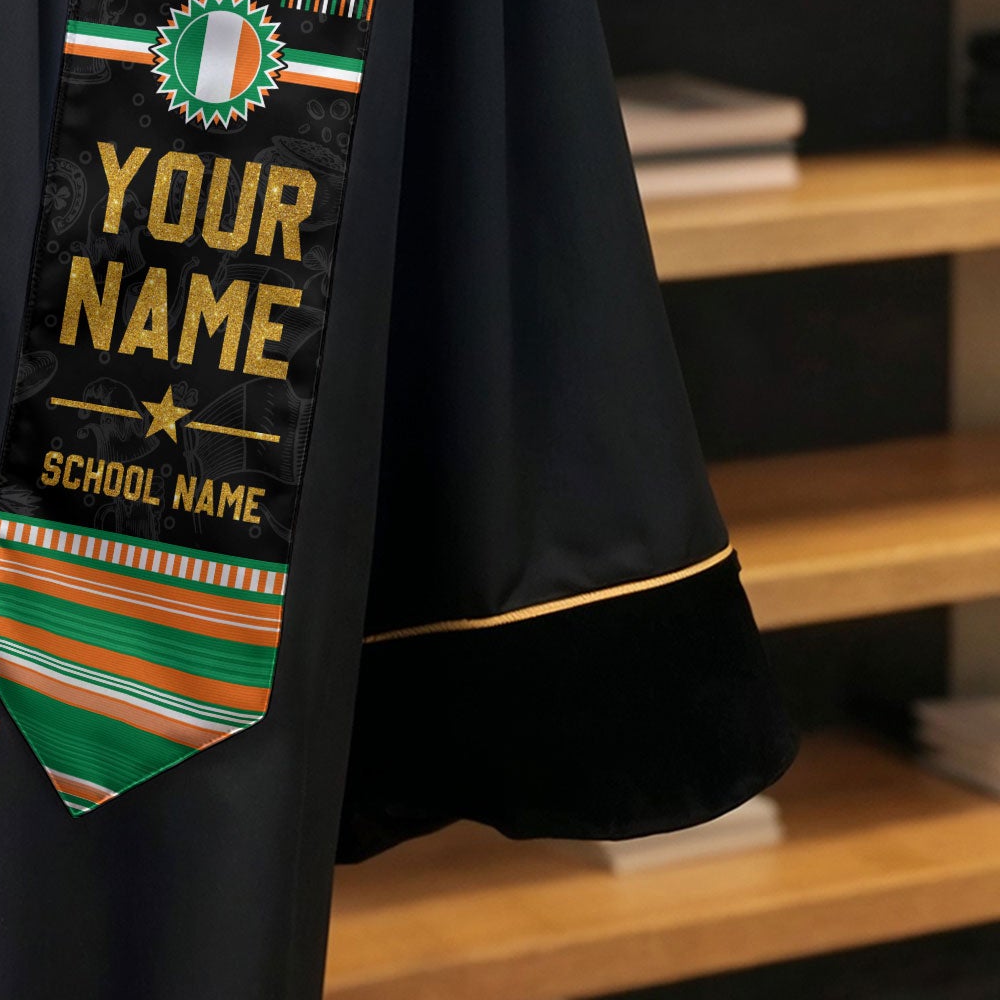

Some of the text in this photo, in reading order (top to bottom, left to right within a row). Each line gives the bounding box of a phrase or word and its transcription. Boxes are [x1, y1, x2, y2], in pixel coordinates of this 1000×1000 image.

[97, 141, 317, 261] YOUR
[59, 256, 303, 380] NAME
[41, 451, 265, 524] SCHOOL NAME
